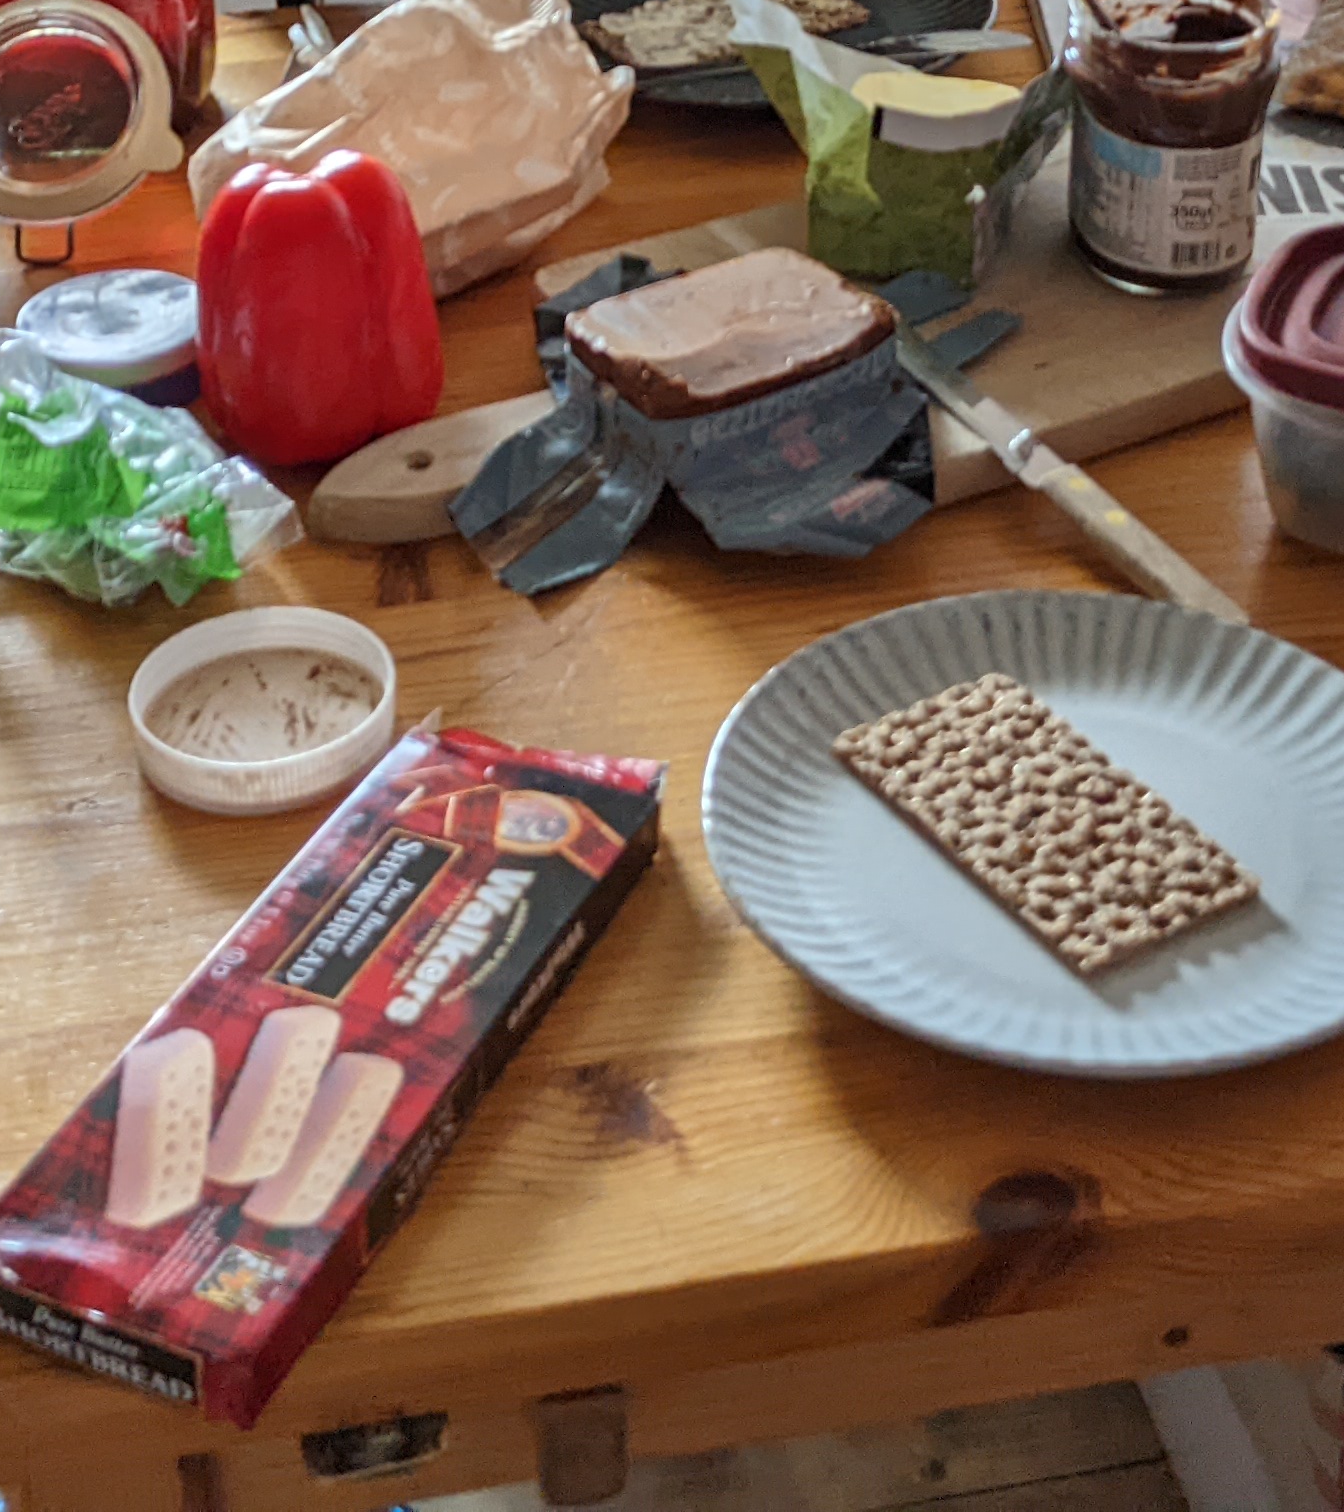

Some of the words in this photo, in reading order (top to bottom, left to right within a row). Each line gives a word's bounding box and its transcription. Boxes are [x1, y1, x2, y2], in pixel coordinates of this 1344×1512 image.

[285, 837, 426, 986] SHORTBREAD
[377, 876, 417, 911] Pure
[384, 868, 537, 1025] Walkers
